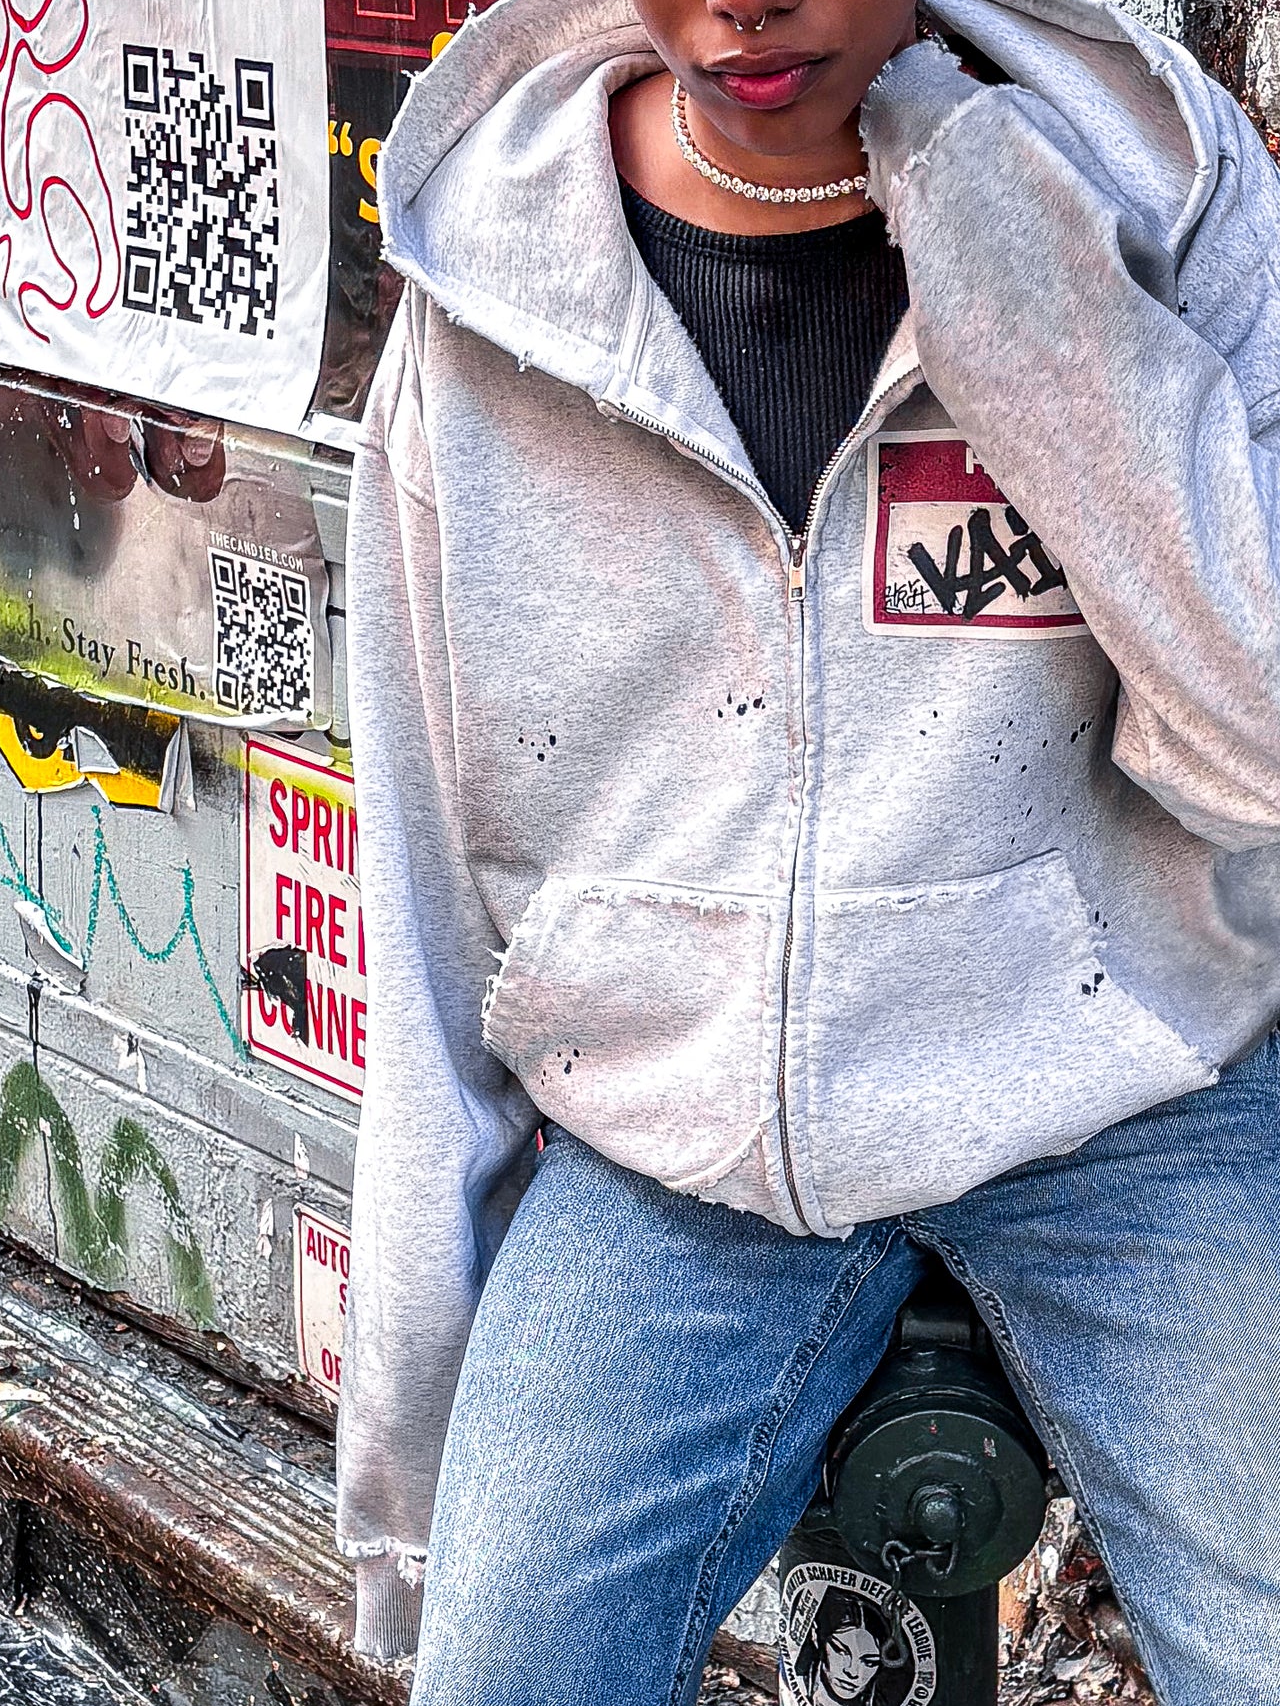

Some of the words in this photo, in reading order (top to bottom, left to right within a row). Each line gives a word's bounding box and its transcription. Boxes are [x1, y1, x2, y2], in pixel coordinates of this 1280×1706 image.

[209, 530, 304, 572] THECANDIER.COM
[61, 616, 116, 677] Stay
[125, 639, 207, 701] Fresh.
[276, 872, 348, 969] FIRE
[306, 1226, 351, 1279] AUTO
[806, 1565, 858, 1587] SCHAFER
